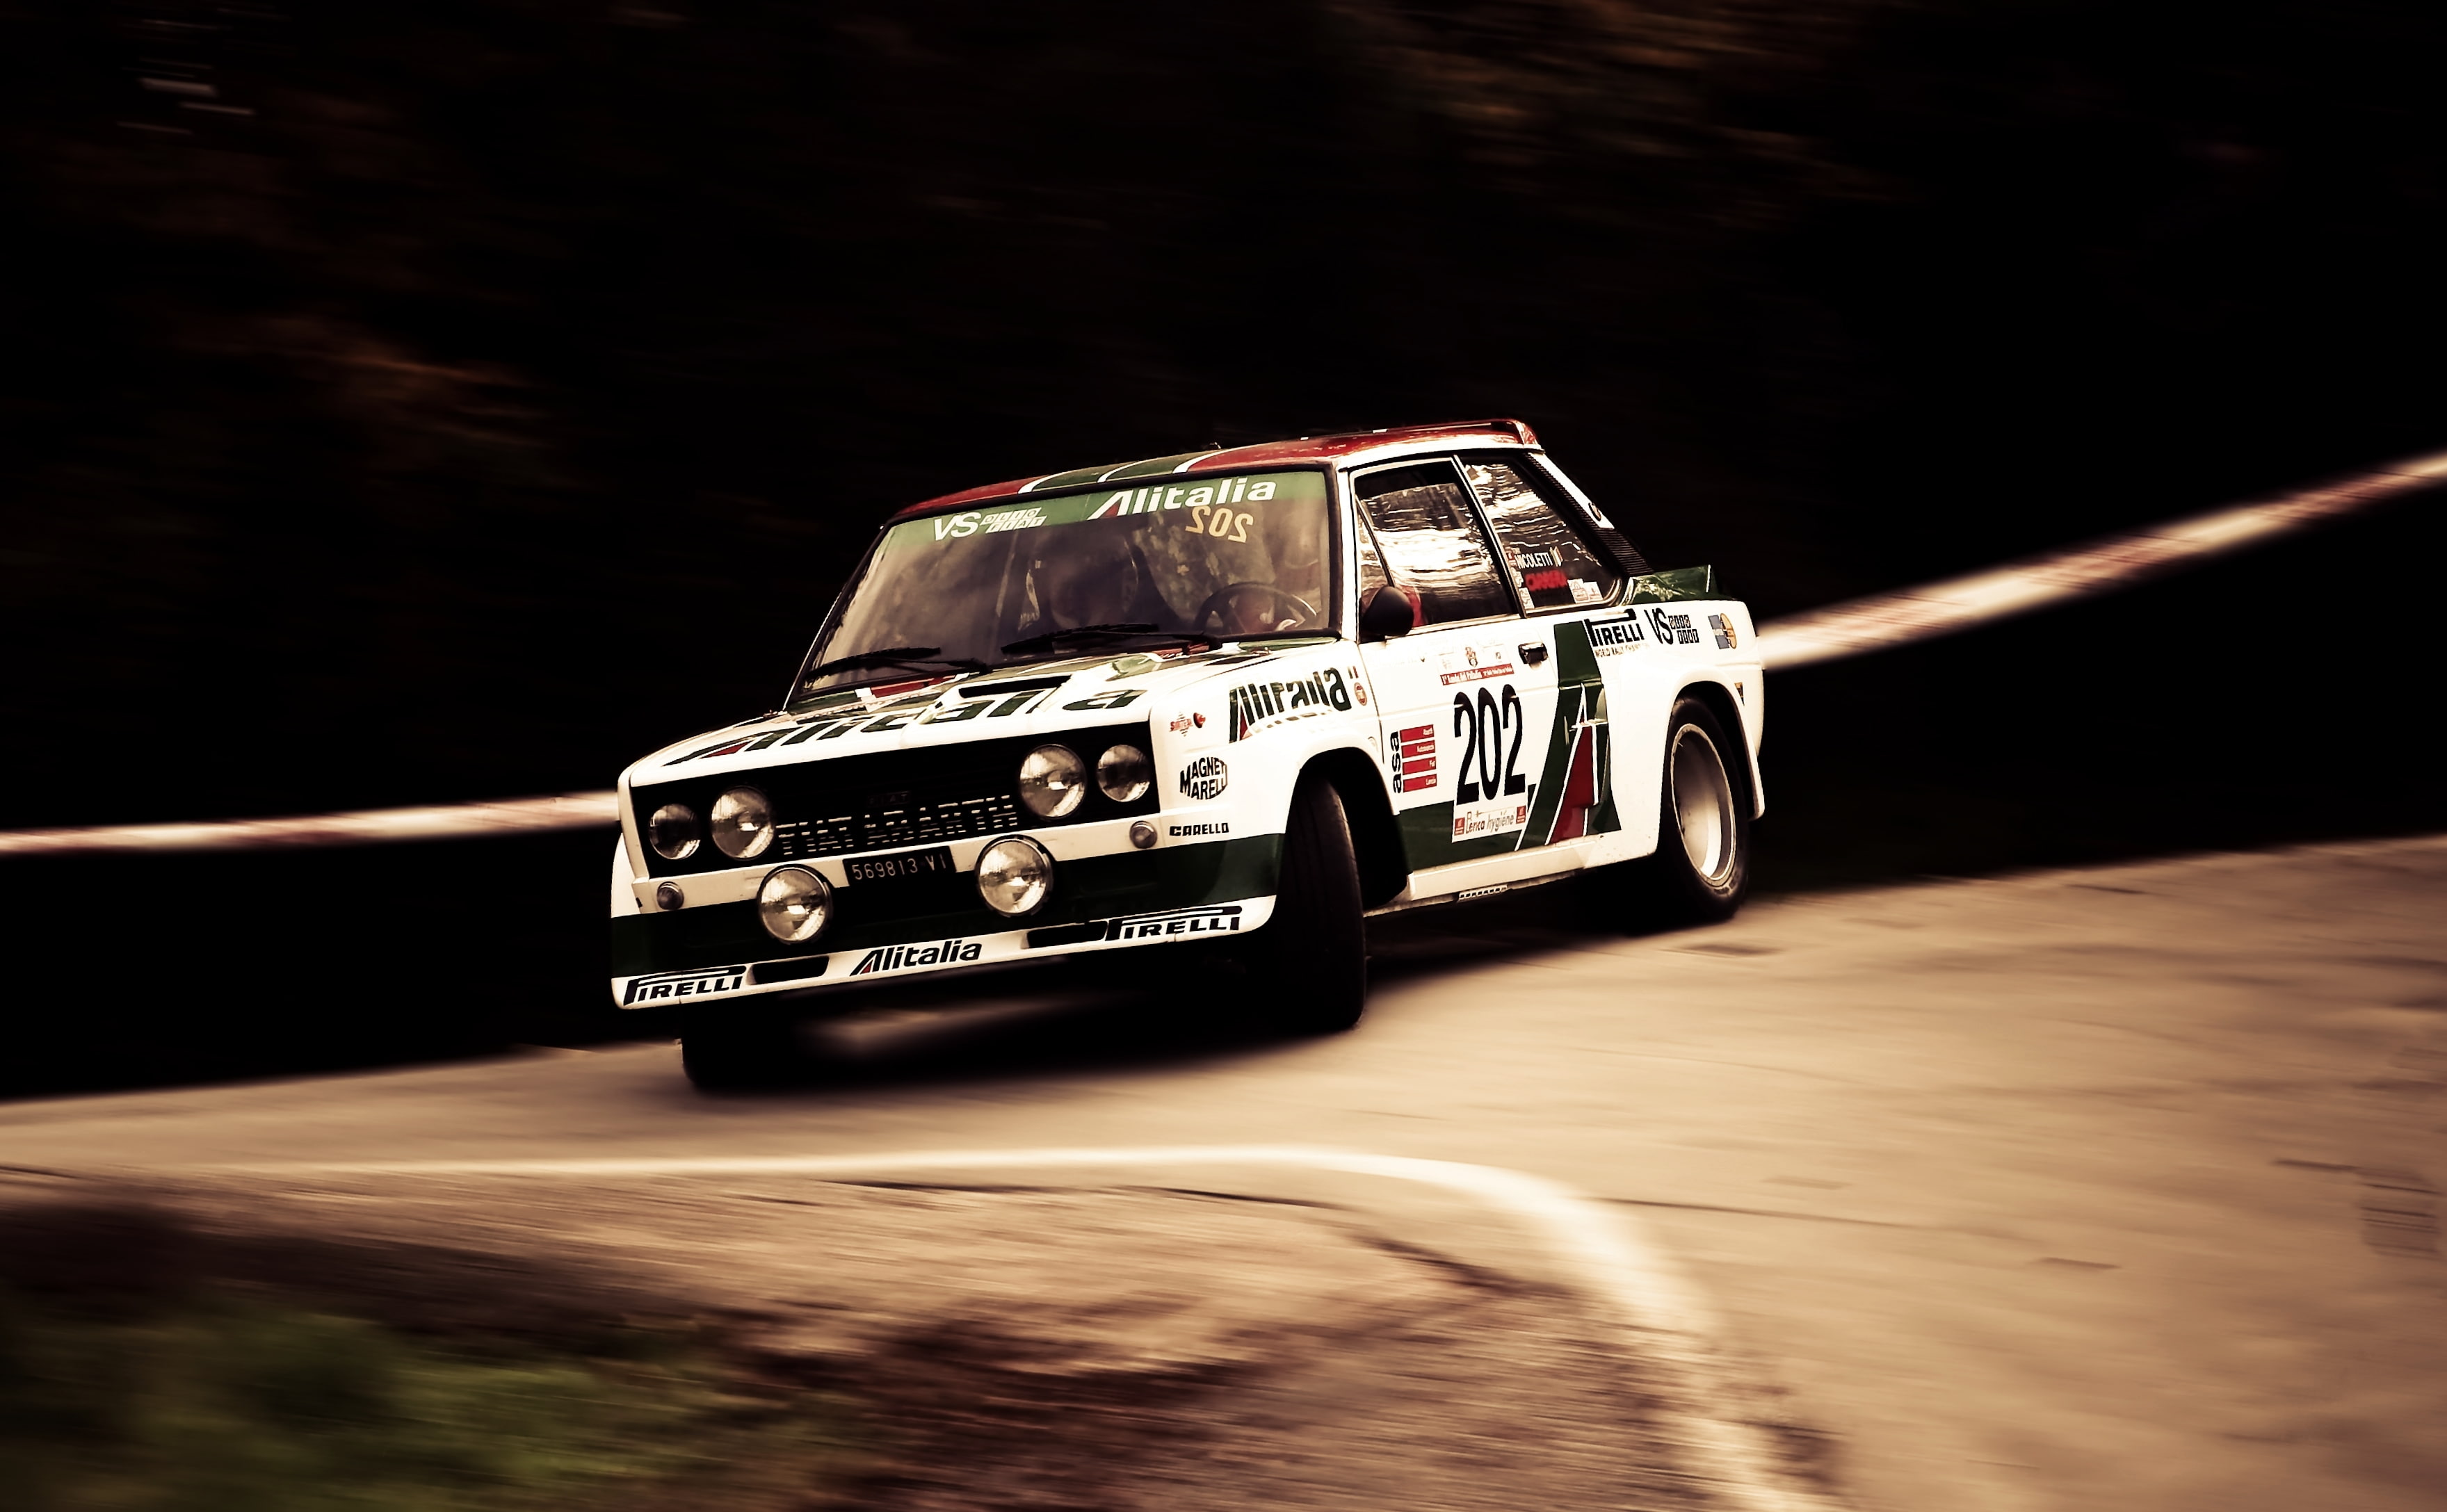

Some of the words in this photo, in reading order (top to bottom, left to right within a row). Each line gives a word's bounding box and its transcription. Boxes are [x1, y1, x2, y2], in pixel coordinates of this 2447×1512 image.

[1087, 478, 1277, 520] Alitalia
[934, 512, 982, 541] VS
[1515, 552, 1553, 569] NICOLETTI
[1584, 608, 1645, 647] PIRELLI
[1644, 608, 1674, 645] VS
[1453, 684, 1526, 805] 202
[852, 859, 918, 880] 569813
[928, 853, 946, 870] VI
[1105, 906, 1243, 941] PIRELLI
[850, 940, 983, 976] Alitalia
[623, 965, 747, 1005] PIRELLI
